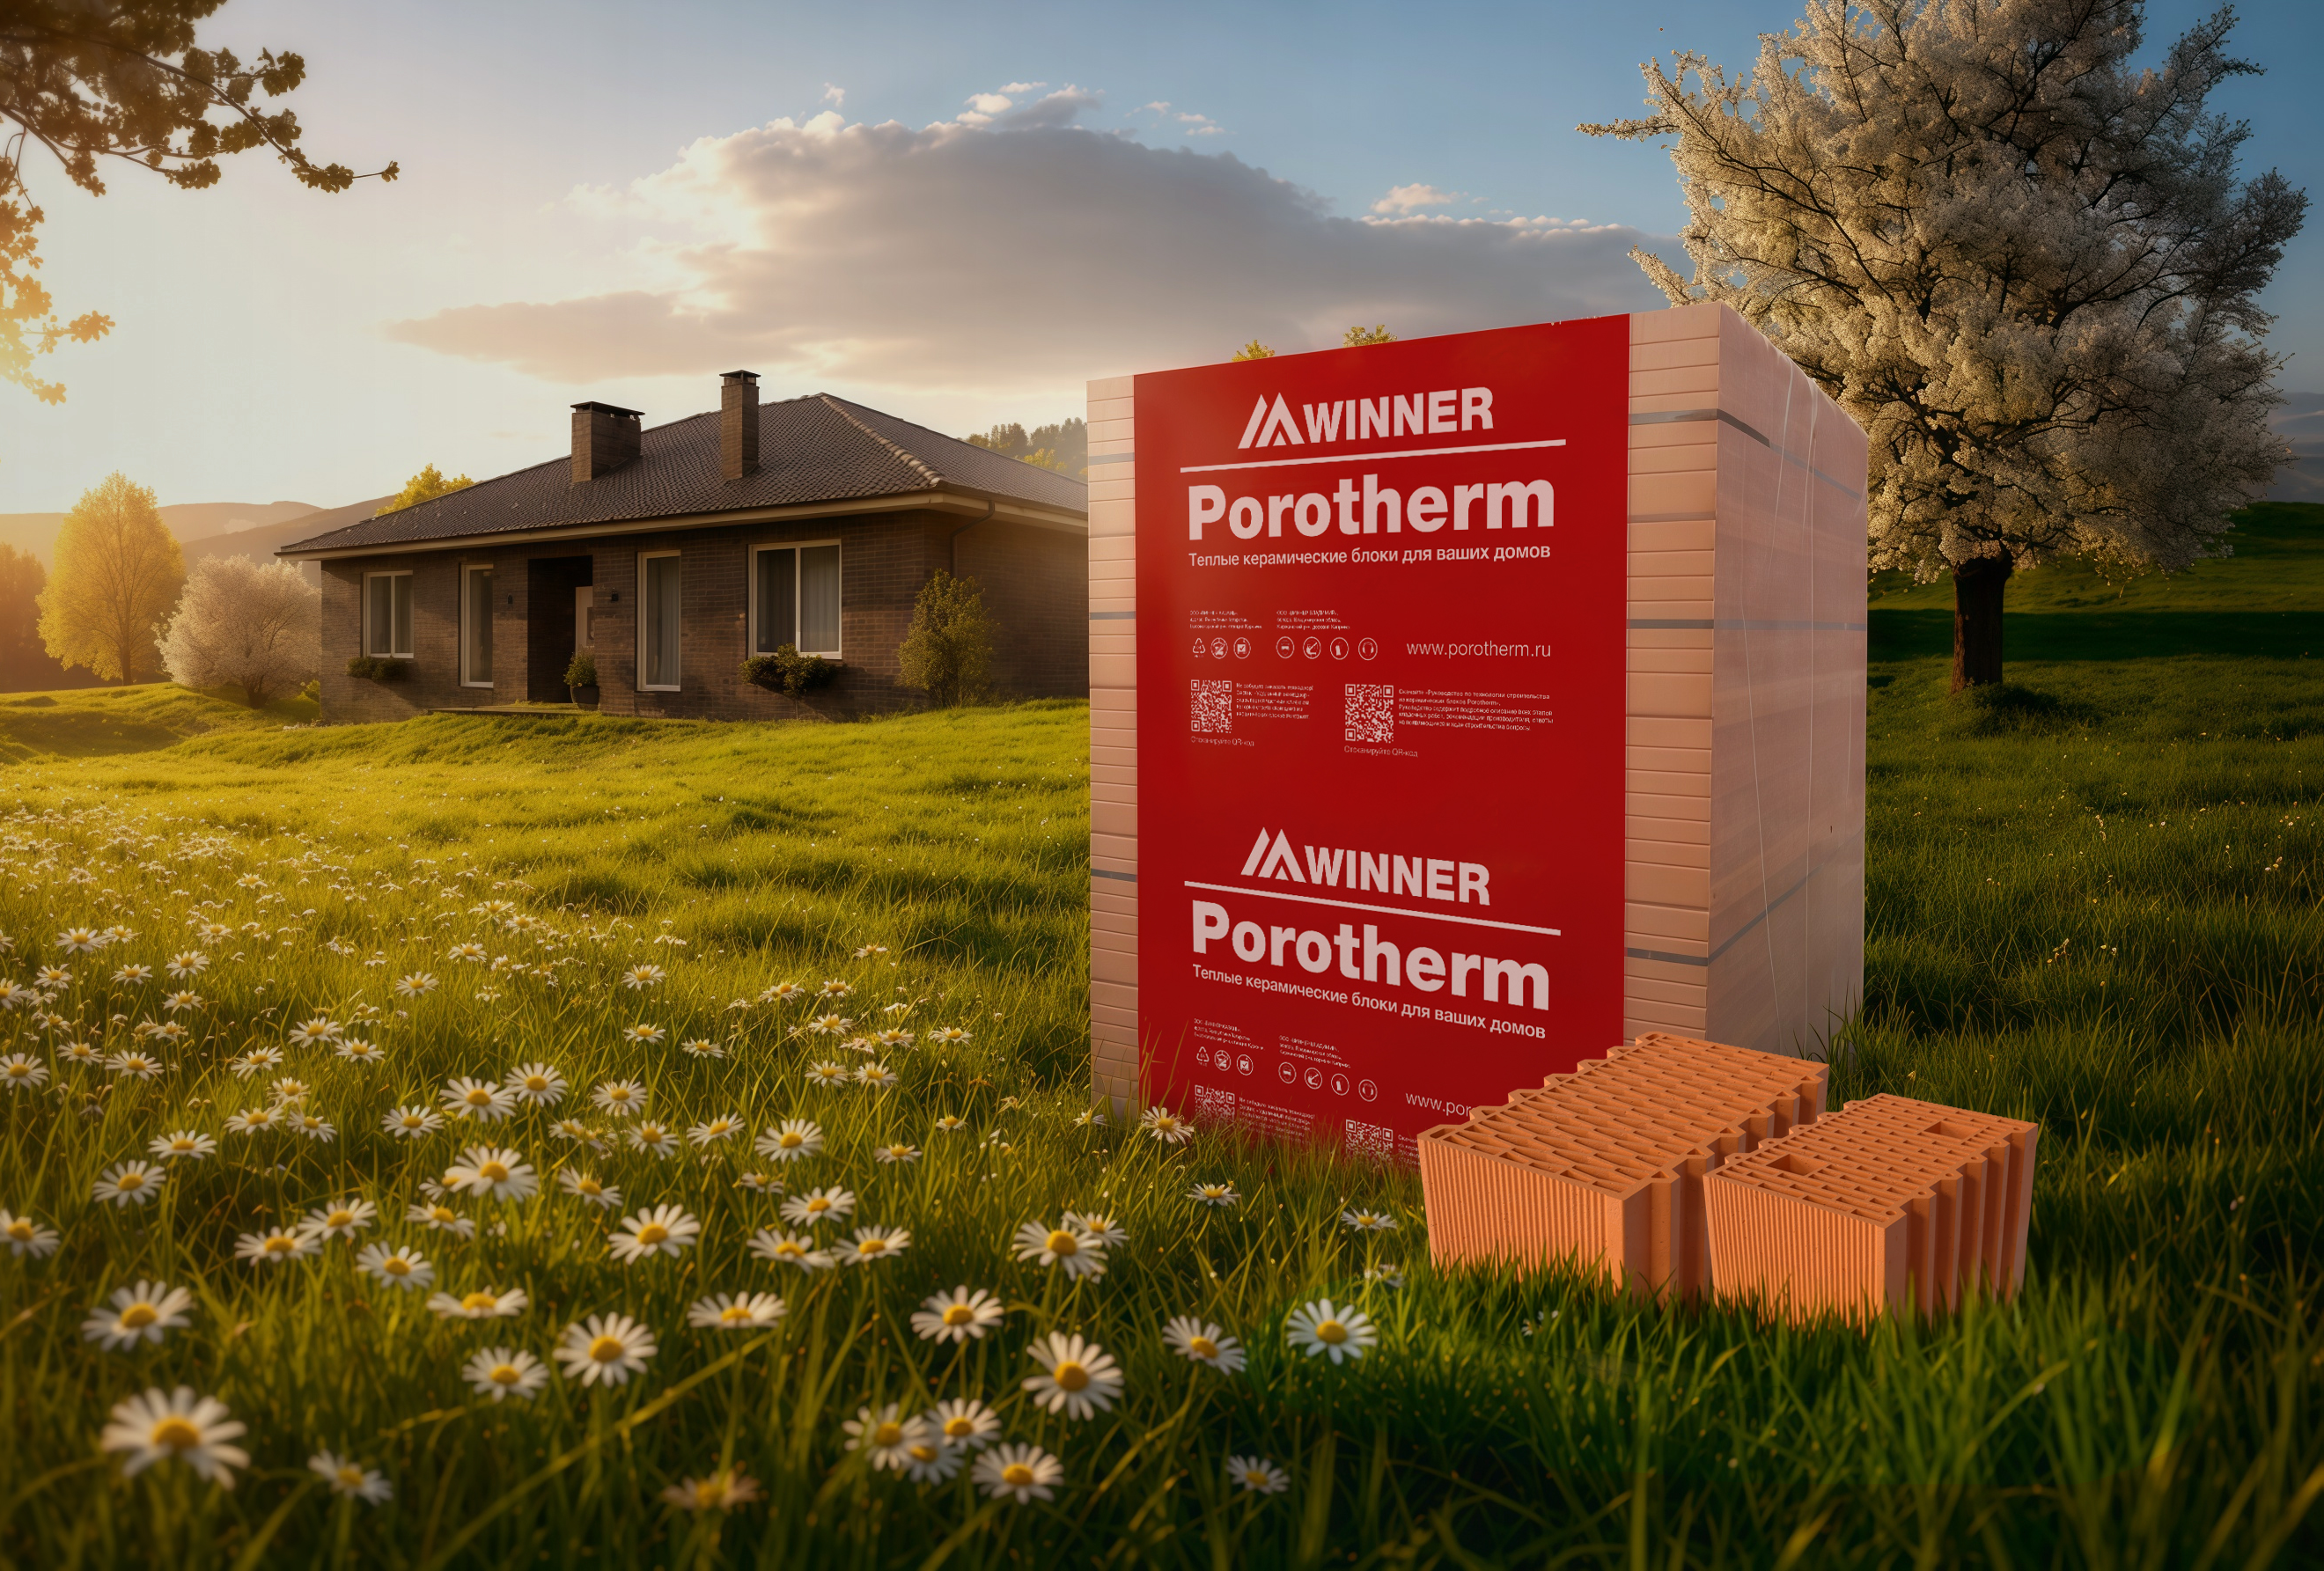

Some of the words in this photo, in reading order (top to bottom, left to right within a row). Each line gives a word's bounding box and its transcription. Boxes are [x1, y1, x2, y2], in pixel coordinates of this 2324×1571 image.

[1303, 387, 1494, 443] WINNER
[1188, 473, 1555, 540] Porotherm
[1188, 552, 1239, 567] Теплые
[1243, 551, 1348, 568] керамические
[1351, 547, 1398, 563] блоки
[1402, 549, 1432, 564] для
[1437, 547, 1489, 561] ваших
[1494, 546, 1551, 562] домов
[1407, 640, 1551, 659] www.porotherm.ru
[1305, 845, 1490, 907] WINNER
[1192, 900, 1549, 1011] Porotherm
[1192, 964, 1243, 986] Теплые
[1246, 976, 1349, 1004] керамические
[1351, 992, 1398, 1013] блоки
[1401, 1003, 1430, 1019] для
[1435, 1009, 1487, 1028] ваших
[1489, 1019, 1546, 1040] домов
[1405, 1092, 1472, 1117] www.por
